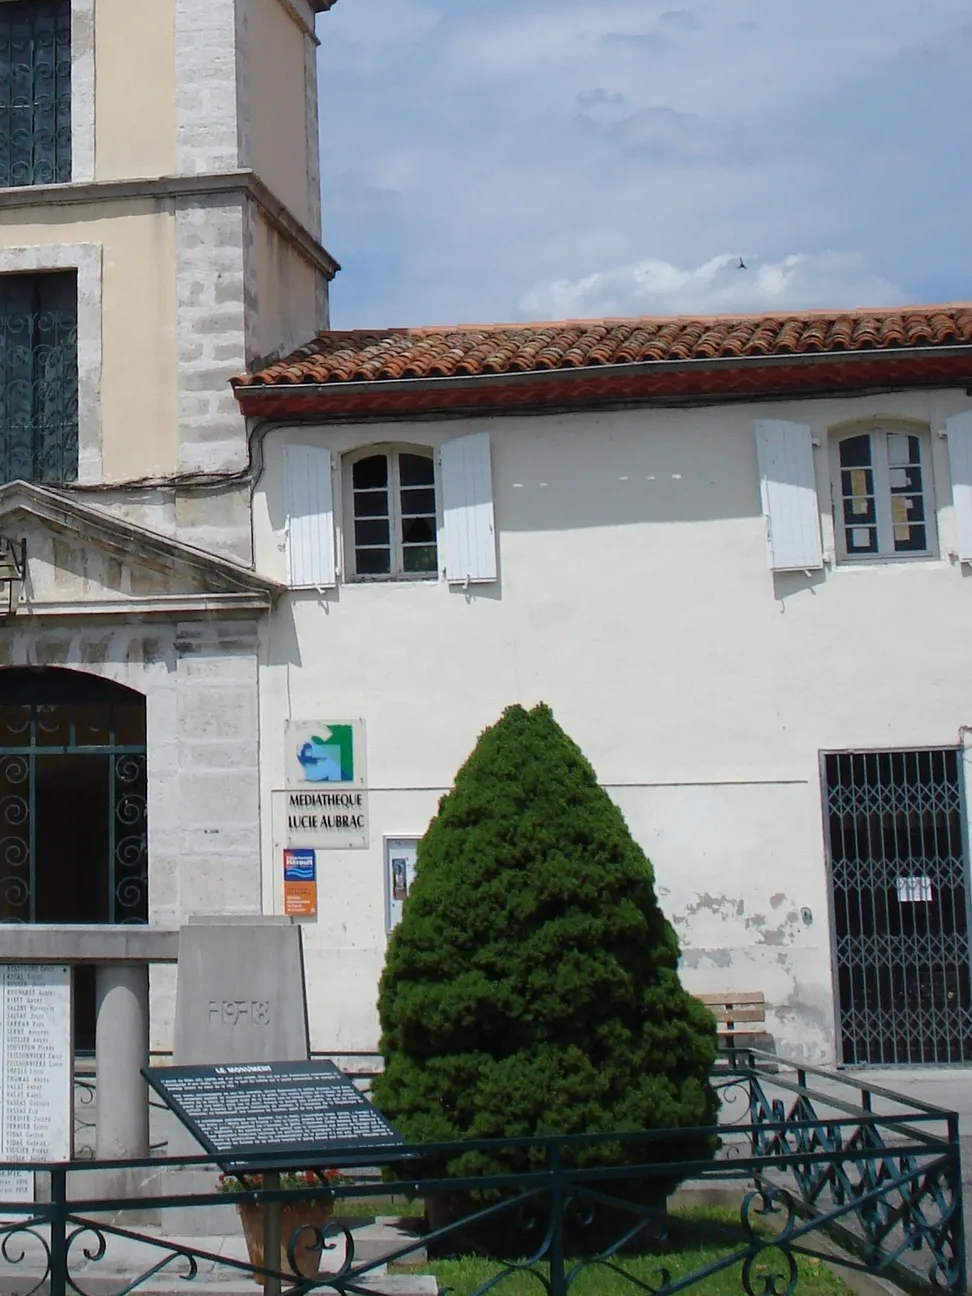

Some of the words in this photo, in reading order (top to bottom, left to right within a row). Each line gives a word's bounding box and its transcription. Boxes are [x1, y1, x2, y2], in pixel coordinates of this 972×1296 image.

[289, 793, 362, 808] MEDIATHEQUE
[288, 815, 318, 829] LUCIE
[320, 814, 365, 829] AUBRAC
